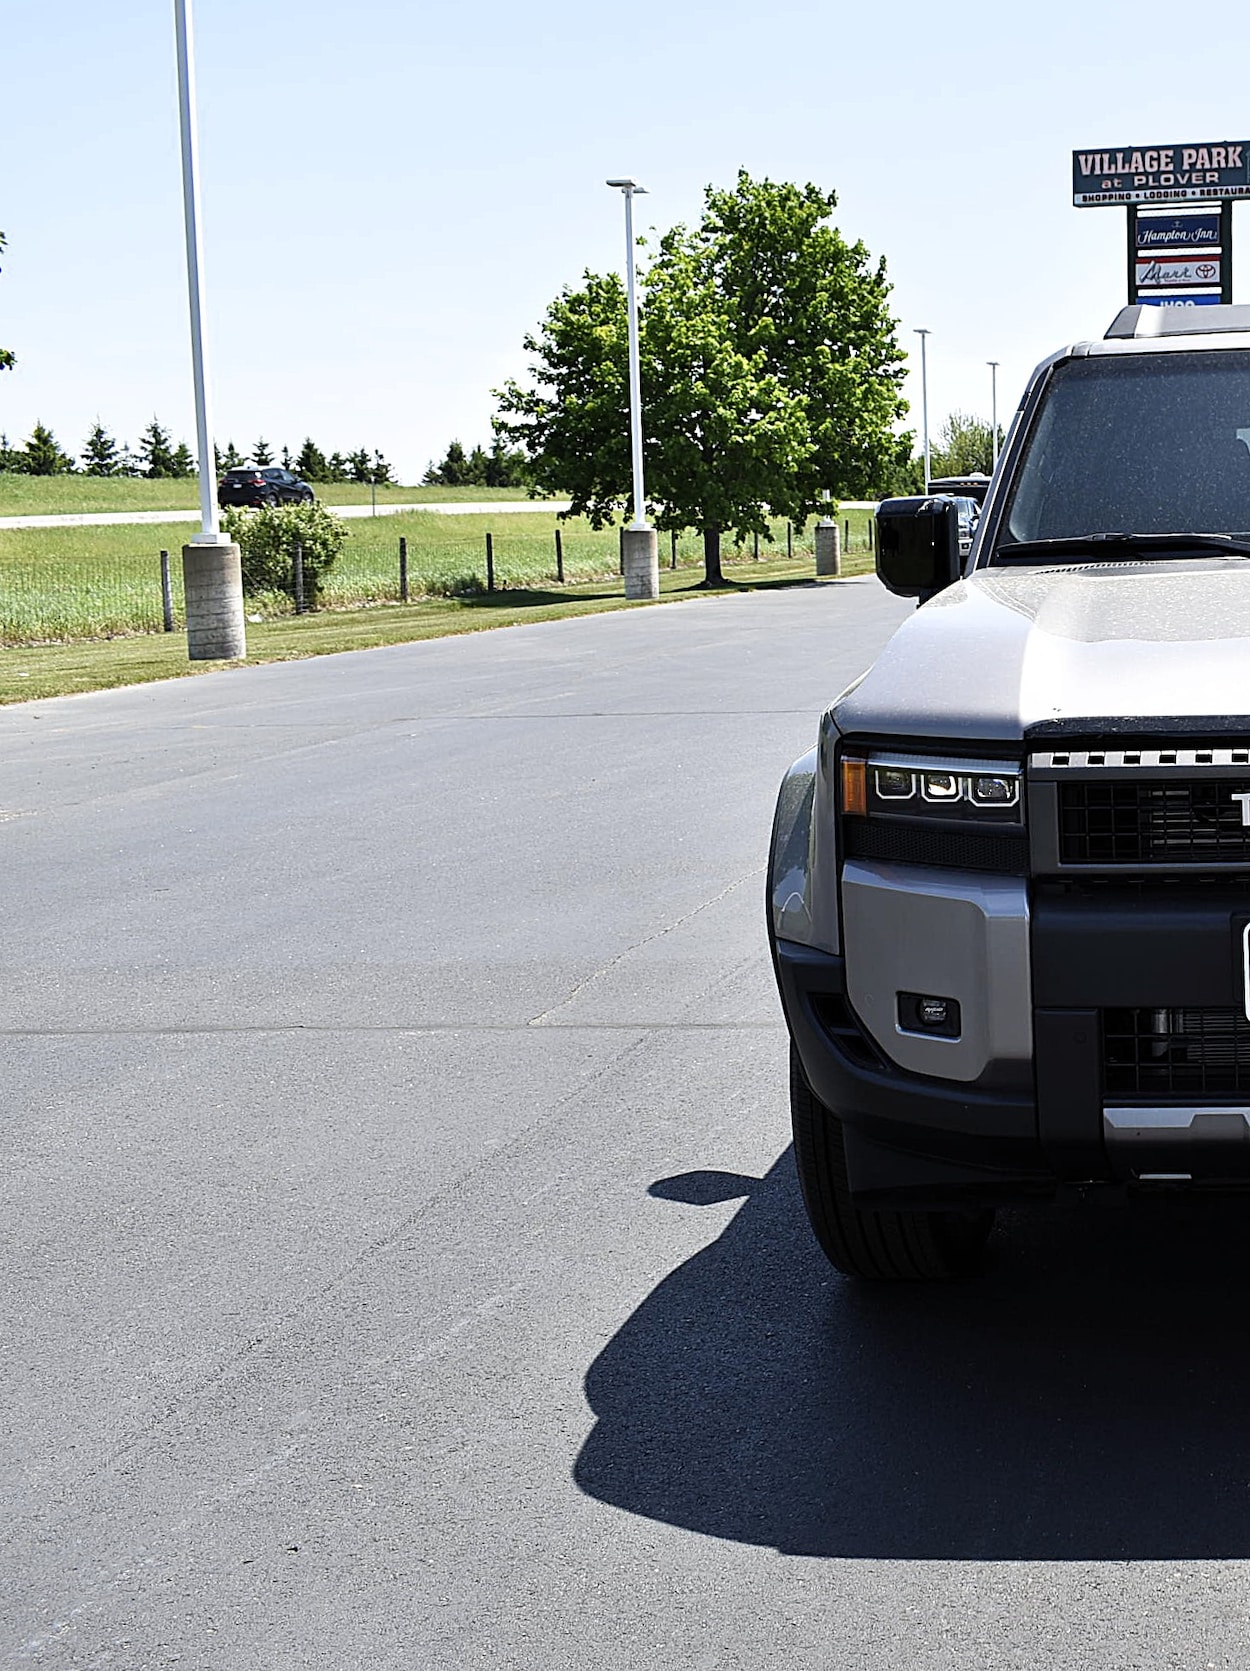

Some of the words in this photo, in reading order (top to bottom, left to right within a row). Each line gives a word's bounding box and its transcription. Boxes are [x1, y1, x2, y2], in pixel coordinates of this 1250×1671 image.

[1079, 151, 1174, 175] VILLAGE
[1182, 146, 1243, 170] PARK
[1101, 178, 1123, 189] at
[1133, 171, 1220, 187] PLOVER
[1082, 192, 1132, 203] SHOPPING
[1143, 189, 1187, 200] LODGING
[1138, 230, 1190, 244] Hampton
[1191, 227, 1217, 242] Inn
[1139, 260, 1192, 285] Mark
